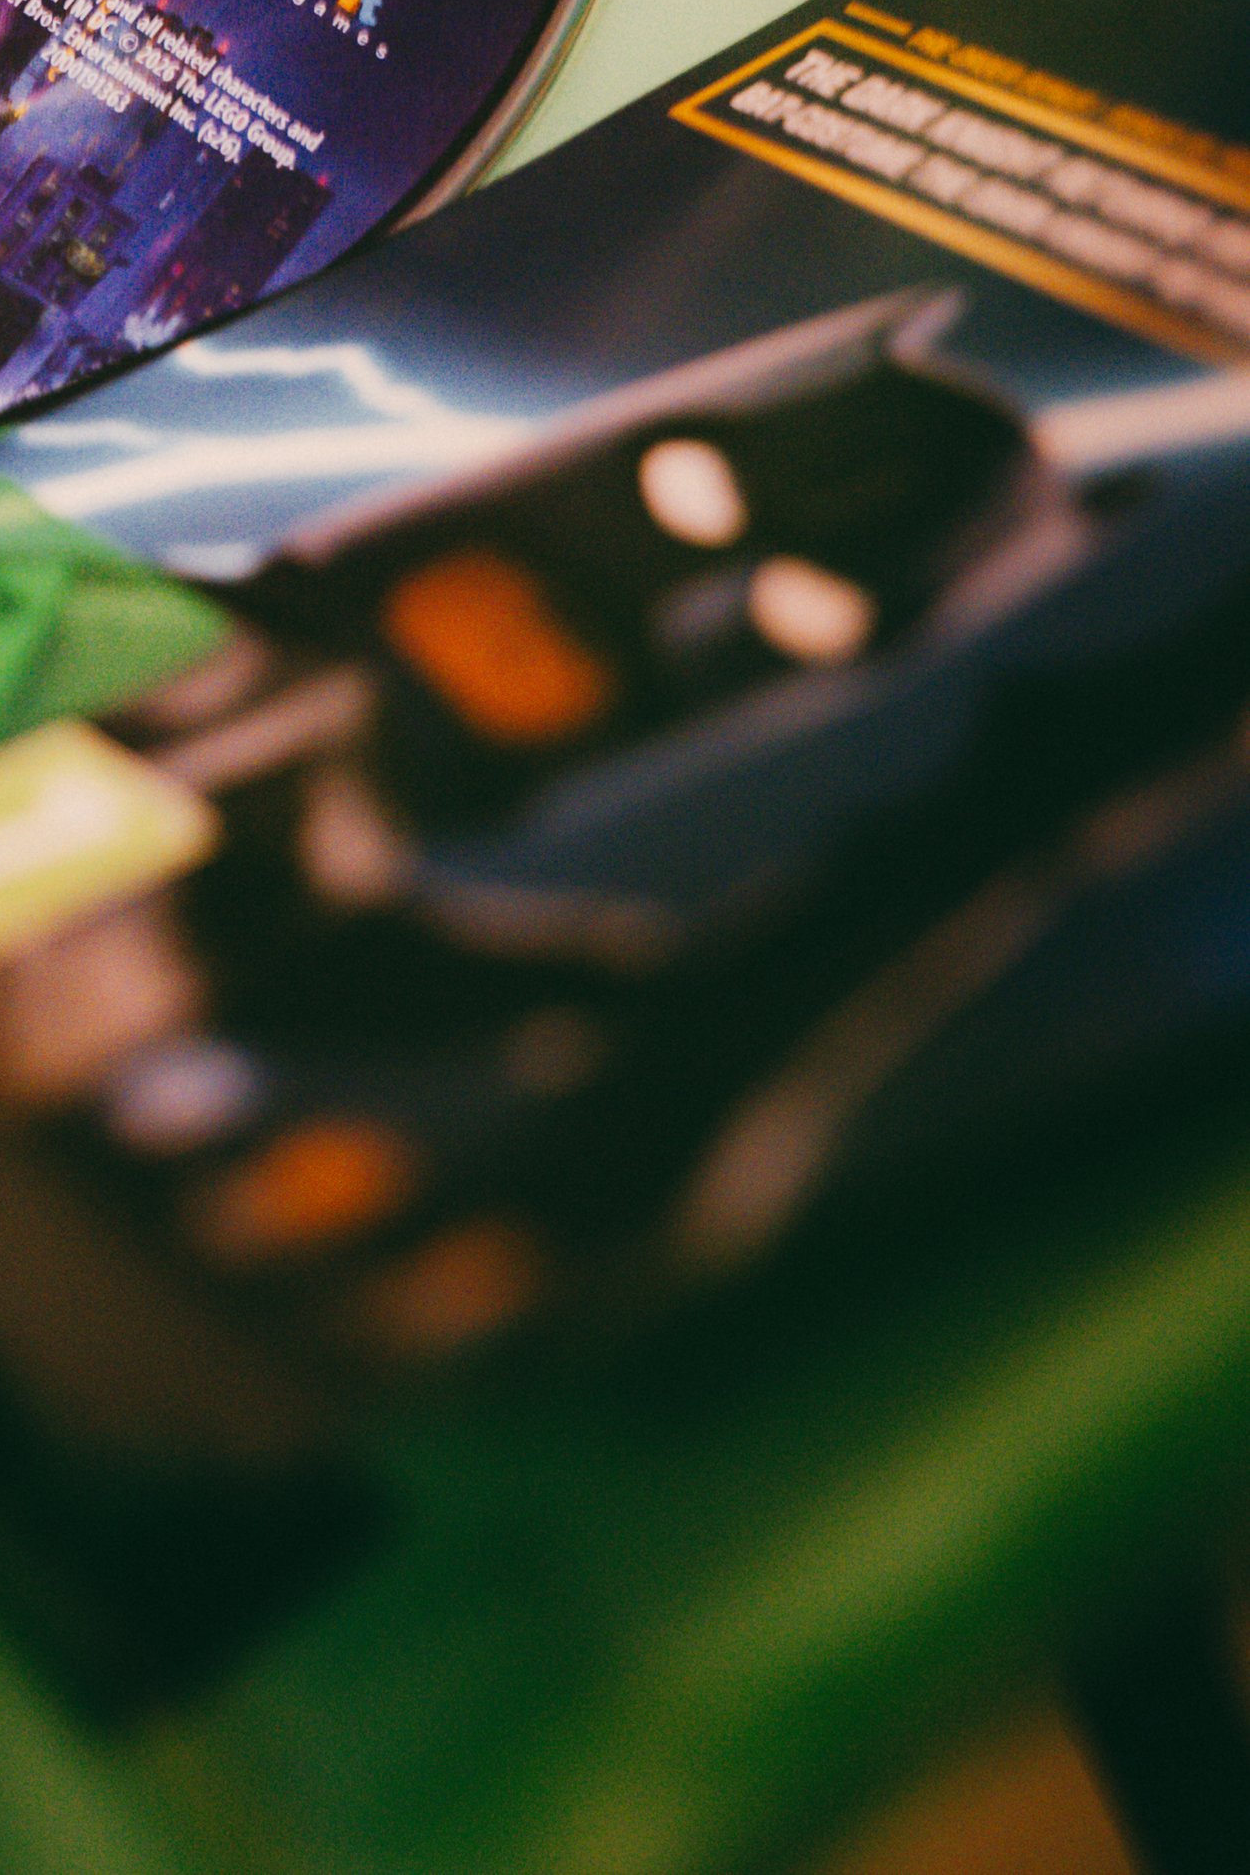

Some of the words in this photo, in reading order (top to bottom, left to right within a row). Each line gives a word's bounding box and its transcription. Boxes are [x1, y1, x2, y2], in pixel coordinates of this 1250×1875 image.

[62, 22, 173, 112] Entertainment
[168, 99, 197, 132] Inc.
[133, 42, 180, 82] 2026
[175, 69, 206, 104] The
[203, 89, 250, 132] LEGO
[136, 16, 163, 39] all
[156, 30, 217, 76] related
[211, 66, 290, 130] characters
[287, 123, 324, 152] and
